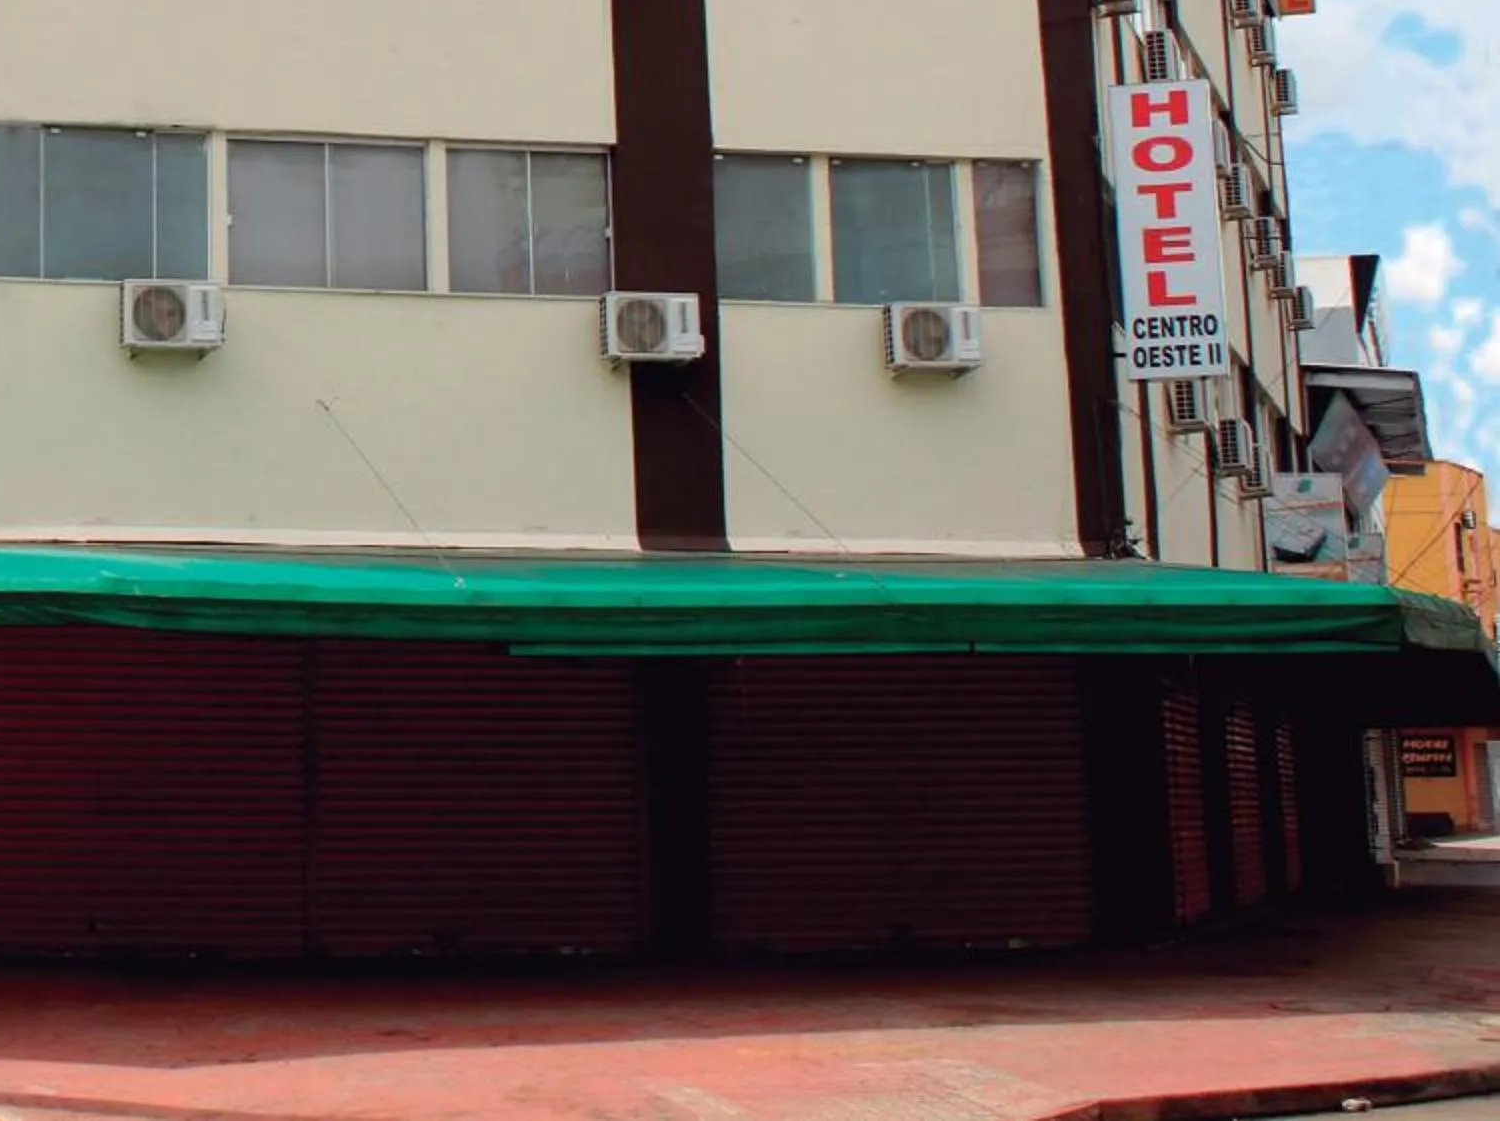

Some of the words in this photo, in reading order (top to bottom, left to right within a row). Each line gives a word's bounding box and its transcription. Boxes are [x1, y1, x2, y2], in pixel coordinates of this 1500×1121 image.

[1130, 90, 1197, 307] HOTEL
[1132, 313, 1219, 340] CENTRO
[1132, 343, 1201, 369] OESTE
[1208, 342, 1222, 366] II
